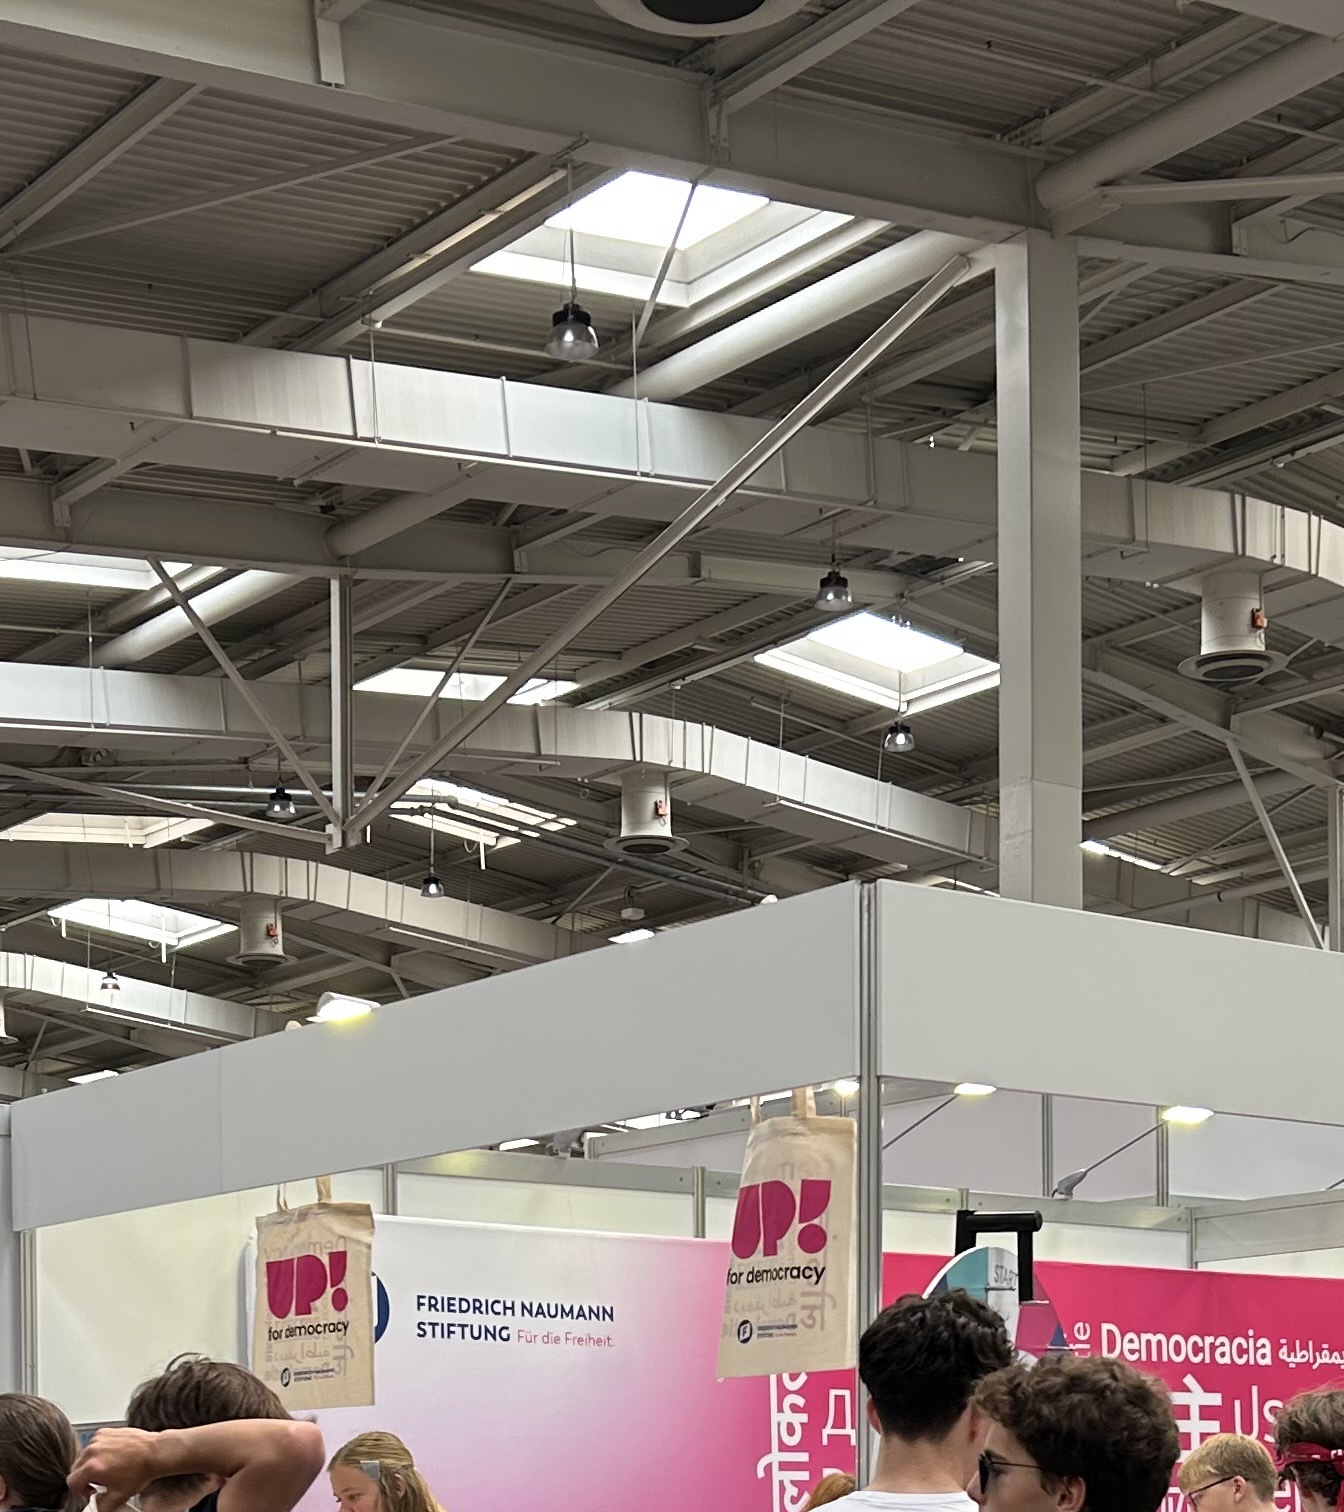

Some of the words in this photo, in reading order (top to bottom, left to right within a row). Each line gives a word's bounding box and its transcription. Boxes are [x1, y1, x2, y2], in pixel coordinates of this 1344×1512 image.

[731, 1178, 832, 1260] UP!
[265, 1250, 348, 1319] UP!
[727, 1267, 744, 1286] for
[746, 1264, 826, 1286] democracy
[416, 1294, 516, 1317] FRIEDRICH
[520, 1301, 615, 1322] NAUMANN
[268, 1326, 284, 1342] for
[284, 1320, 350, 1340] democracy
[416, 1321, 511, 1342] STIFTUNG
[517, 1329, 537, 1344] Für
[541, 1330, 561, 1345] die
[1101, 1322, 1272, 1366] Democracia
